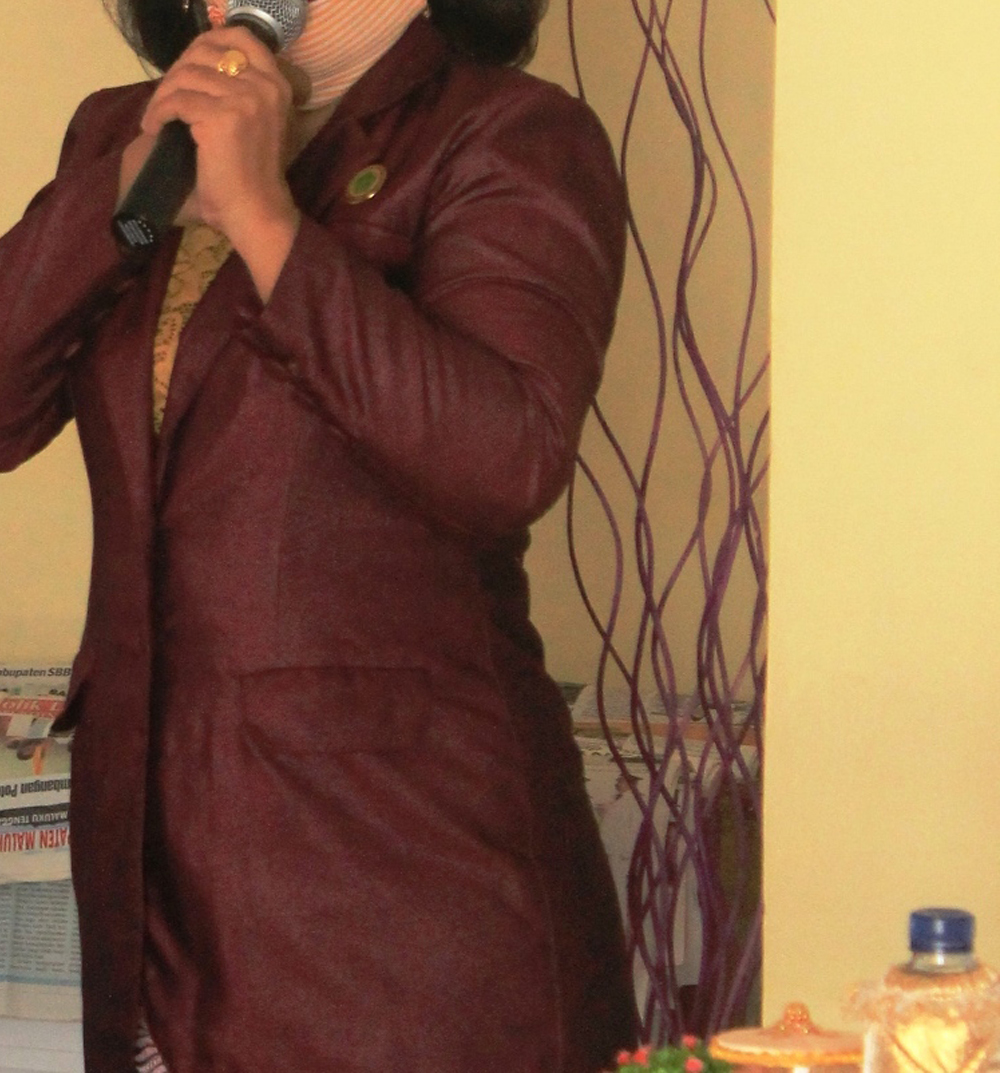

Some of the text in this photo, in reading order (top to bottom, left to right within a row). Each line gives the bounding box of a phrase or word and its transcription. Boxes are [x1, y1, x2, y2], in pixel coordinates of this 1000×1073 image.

[47, 667, 72, 677] SBB
[32, 811, 68, 823] MALUKU
[40, 826, 71, 849] ATEN
